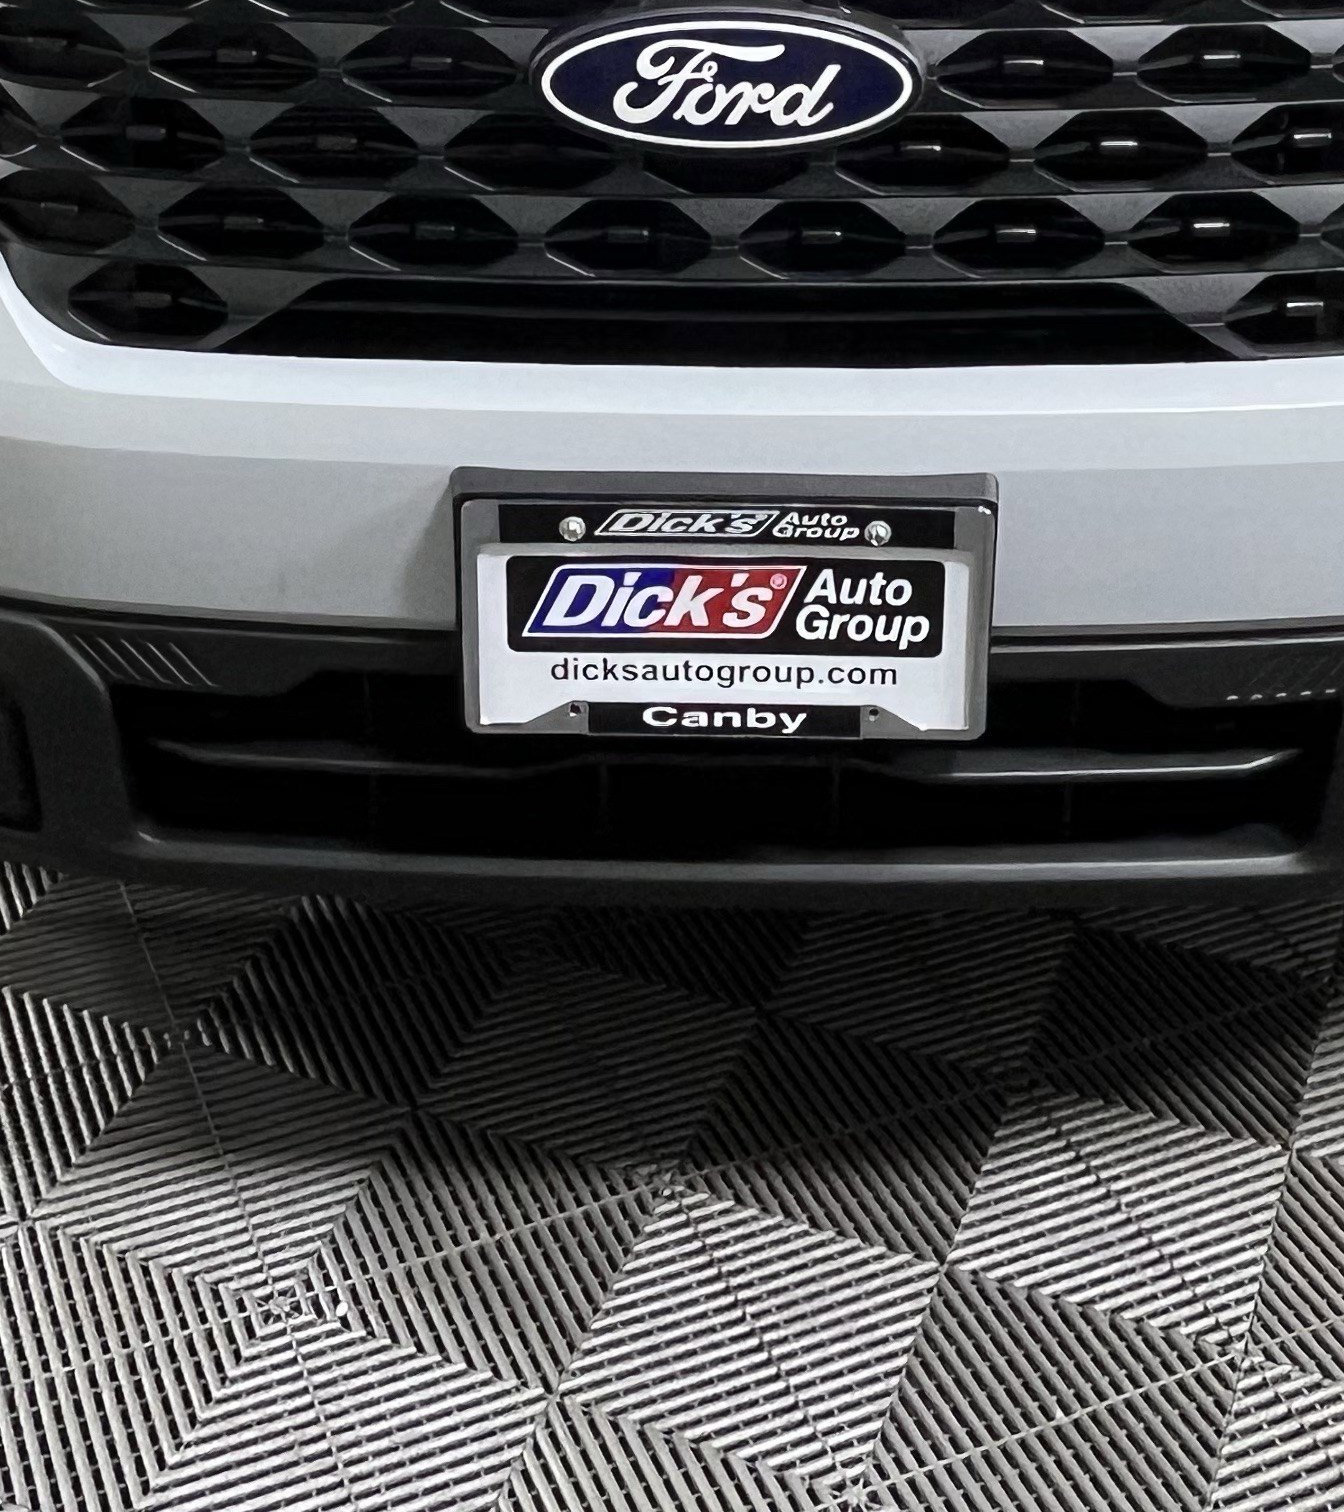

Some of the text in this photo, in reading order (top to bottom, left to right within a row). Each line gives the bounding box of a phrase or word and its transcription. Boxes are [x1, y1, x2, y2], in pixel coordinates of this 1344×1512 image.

[613, 39, 841, 126] Ford
[608, 511, 768, 535] Dick's
[772, 524, 860, 541] Group
[781, 511, 849, 528] Auto
[804, 570, 913, 607] Auto
[796, 605, 930, 650] Group
[550, 659, 898, 688] dicksautogroup.com
[642, 706, 808, 734] Canby
